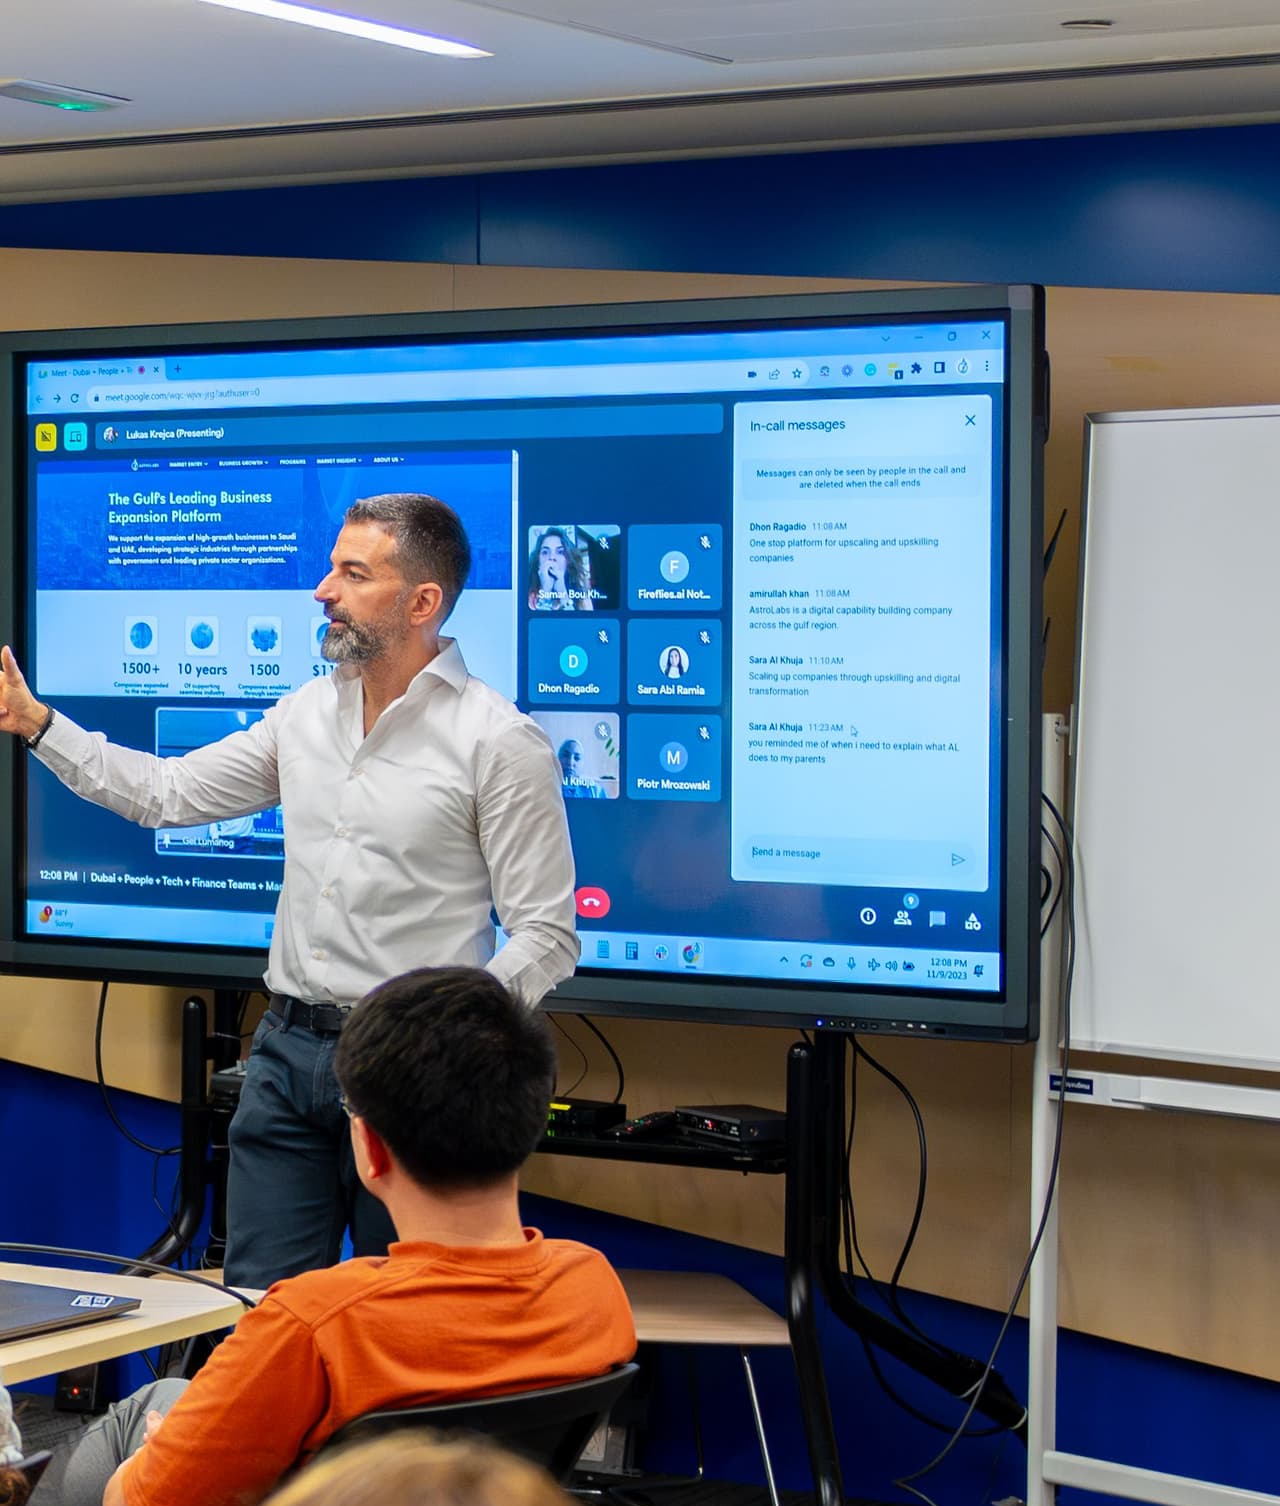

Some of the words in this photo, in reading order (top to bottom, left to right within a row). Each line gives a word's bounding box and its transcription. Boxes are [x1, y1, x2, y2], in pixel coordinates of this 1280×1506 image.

[750, 420, 785, 432] In-call
[788, 419, 846, 432] messages
[126, 430, 149, 440] Lukas
[150, 429, 174, 441] Krejca
[176, 427, 224, 439] (Presenting)
[108, 493, 130, 505] The
[133, 491, 166, 505] Gulf's
[169, 491, 216, 507] Leading
[220, 490, 272, 504] Business
[108, 511, 168, 526] Expansion
[171, 510, 222, 523] Platform
[749, 523, 771, 531] Dhon
[773, 522, 807, 533] Ragadio
[749, 539, 766, 547] One
[768, 540, 786, 549] stop
[788, 538, 822, 549] platform
[824, 538, 836, 546] for
[838, 538, 879, 548] upscaling
[881, 538, 896, 546] and
[899, 537, 939, 548] upskilling
[749, 554, 794, 563] companies
[669, 560, 679, 575] F
[569, 589, 586, 599] Bou
[789, 590, 809, 598] khan
[749, 606, 791, 614] AstroLabs
[792, 606, 799, 614] is
[809, 606, 834, 616] digital
[836, 606, 876, 616] capability
[878, 606, 911, 616] building
[913, 607, 952, 616] company
[749, 621, 776, 629] across
[778, 620, 791, 629] the
[793, 620, 809, 630] gulf
[568, 654, 579, 668] D
[749, 656, 767, 664] Sara
[780, 656, 803, 666] Khuja
[122, 662, 160, 674] 1500+
[178, 663, 191, 675] 10
[196, 664, 228, 677] years
[249, 664, 280, 676] 1500
[538, 683, 562, 693] Dhon
[564, 684, 600, 696] Ragadio
[637, 685, 658, 695] Sara
[659, 685, 675, 695] Abi
[676, 685, 705, 696] Ramia
[749, 722, 767, 731] Sara
[779, 723, 803, 733] Khuja
[748, 740, 763, 749] you
[765, 739, 803, 748] reminded
[820, 739, 829, 748] of
[831, 740, 853, 748] when
[859, 740, 880, 749] need
[882, 741, 891, 749] to
[893, 741, 923, 752] explain
[925, 742, 946, 751] what
[666, 751, 680, 764] M
[748, 754, 768, 762] does
[770, 754, 779, 762] to
[781, 756, 793, 764] my
[795, 755, 826, 765] parents
[637, 779, 659, 789] Piotr
[661, 780, 710, 791] Mrozowski
[753, 847, 773, 857] Send
[782, 849, 821, 859] message
[40, 870, 62, 881] 12:08
[64, 871, 78, 881] PM
[90, 872, 116, 883] Dubai
[124, 874, 153, 887] People
[162, 876, 183, 887] Tech
[192, 877, 226, 889] Finance
[228, 879, 256, 890] Teams
[954, 958, 968, 968] PM
[927, 969, 968, 980] 11/9/2023
